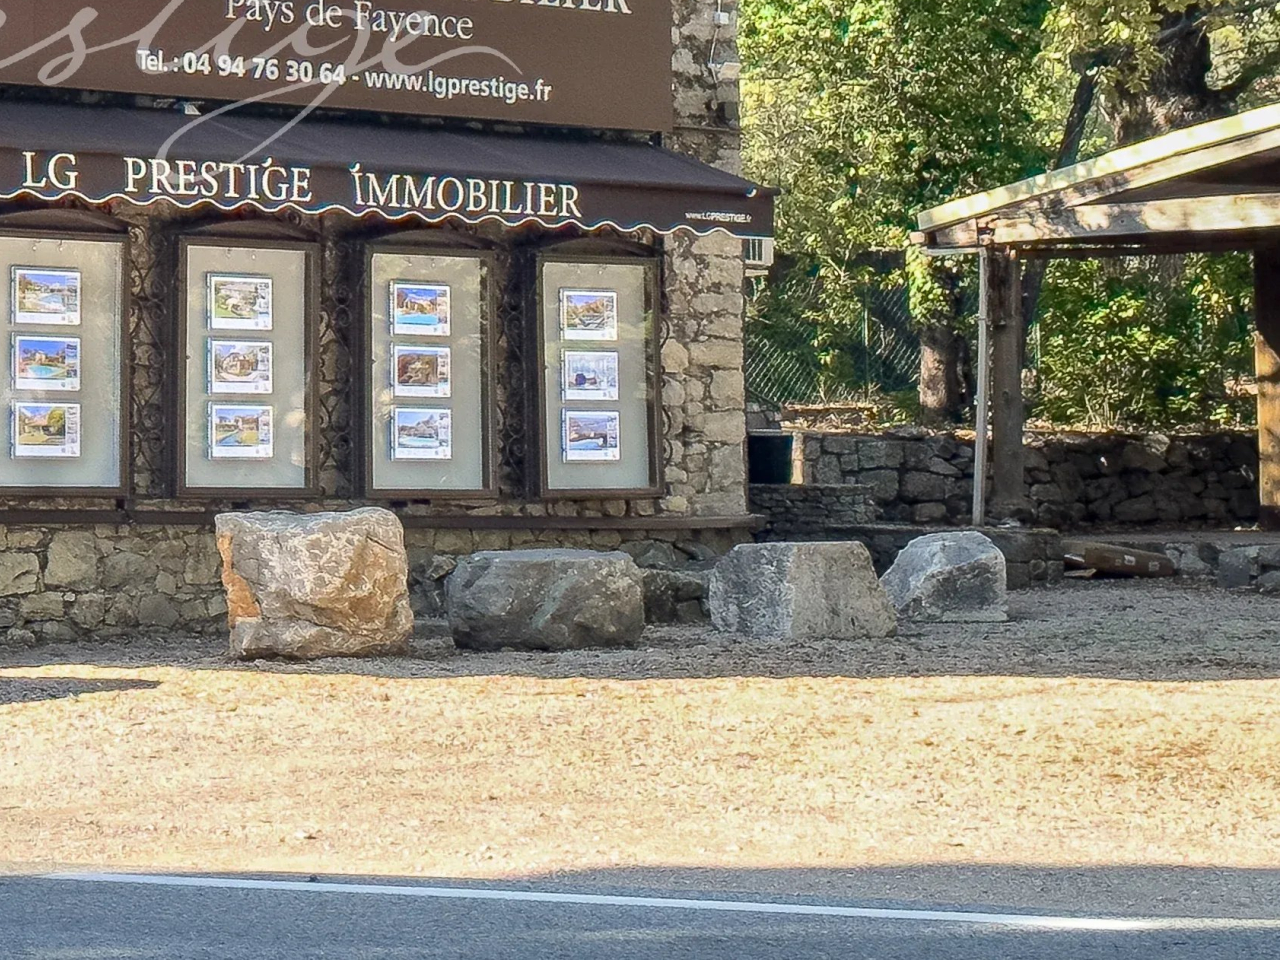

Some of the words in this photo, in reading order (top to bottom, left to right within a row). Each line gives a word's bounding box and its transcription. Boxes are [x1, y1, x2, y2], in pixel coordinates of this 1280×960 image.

[183, 51, 212, 76] 04
[218, 54, 246, 79] 94
[252, 57, 280, 81] 76
[285, 60, 314, 84] 30
[319, 62, 346, 86] 64
[364, 69, 553, 105] www.lgprestige.fr
[21, 151, 79, 189] LG
[123, 156, 313, 202] PRESTIGE
[351, 170, 583, 218] IMMOBILIER
